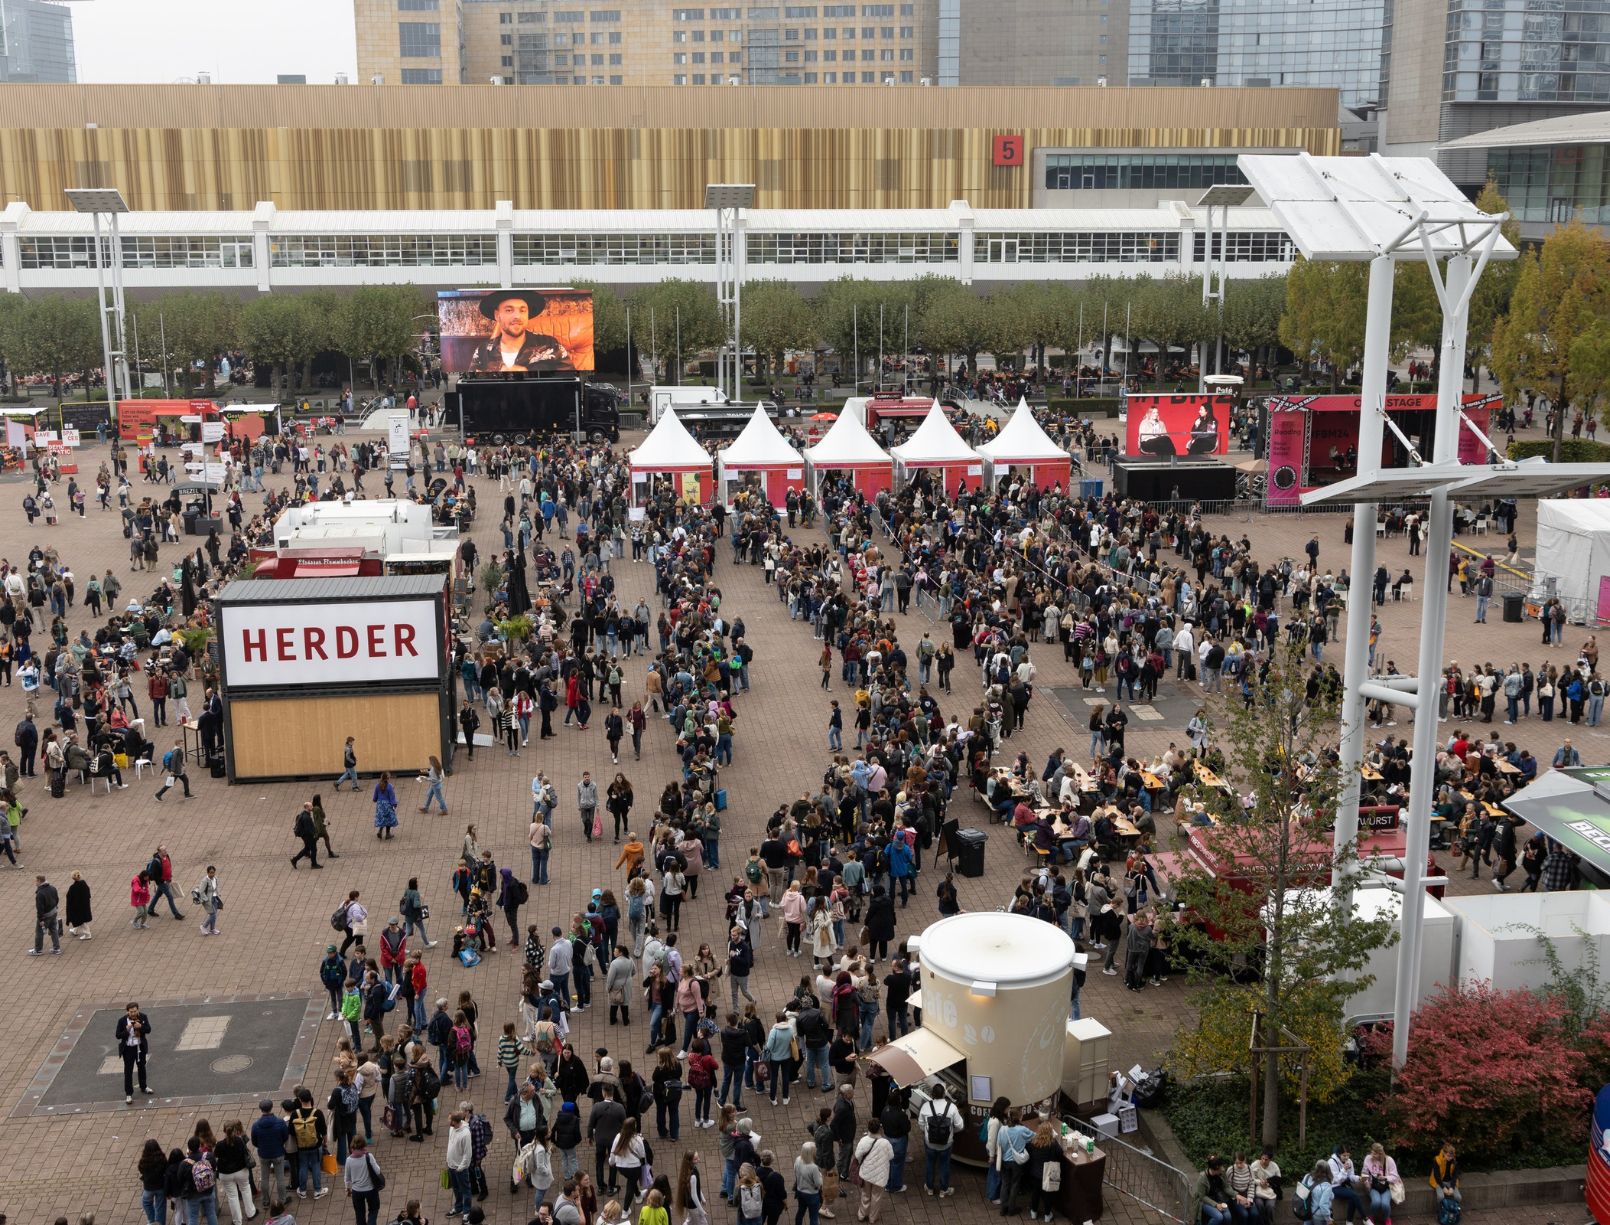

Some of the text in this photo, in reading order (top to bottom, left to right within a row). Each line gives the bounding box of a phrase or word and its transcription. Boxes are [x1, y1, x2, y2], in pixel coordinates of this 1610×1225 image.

[1002, 141, 1015, 160] 5
[1216, 386, 1233, 395] Café
[1386, 398, 1422, 407] STAGE
[242, 623, 419, 662] HERDER
[1358, 815, 1393, 826] WURST
